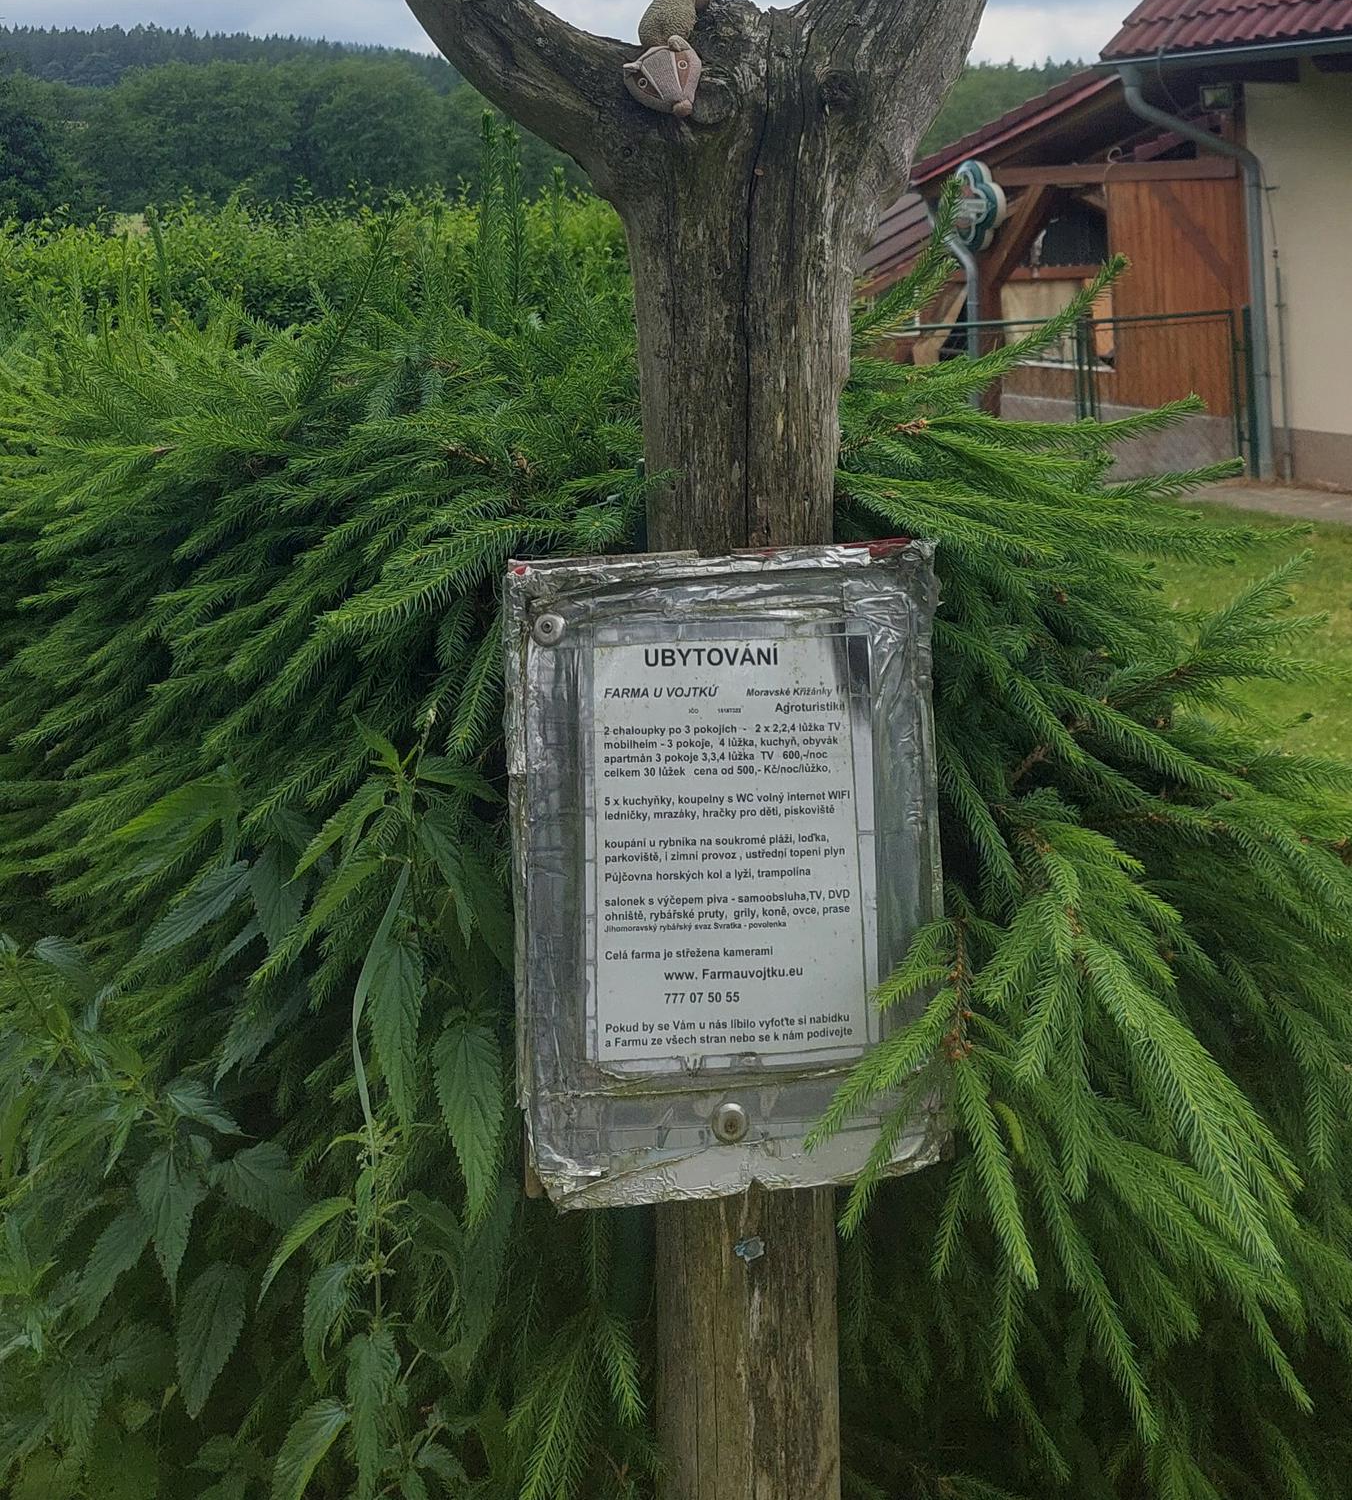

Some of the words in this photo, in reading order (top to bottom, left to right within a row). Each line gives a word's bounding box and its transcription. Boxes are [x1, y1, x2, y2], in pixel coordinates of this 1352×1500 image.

[645, 643, 778, 667] UBYTOVÁNÍ
[604, 688, 649, 698] FARMA
[654, 687, 663, 698] U
[746, 688, 790, 696] Moravské
[793, 687, 832, 697] Křižánky
[604, 726, 609, 735] 2
[613, 726, 666, 737] chaloupky
[669, 727, 681, 736] po
[685, 725, 690, 734] 3
[694, 724, 737, 736] pokojích
[755, 724, 761, 732] 2
[773, 723, 795, 733] 2,2,4
[827, 722, 840, 731] TV
[667, 739, 673, 748] 3
[676, 739, 713, 750] pokoje,
[719, 738, 725, 747] 4
[760, 736, 799, 748] kuchyň,
[803, 736, 838, 747] obyvák
[604, 753, 652, 765] apartmán
[656, 753, 661, 762] 3
[665, 752, 698, 764] pokoje
[702, 752, 725, 763] 3,3,4
[760, 751, 774, 760] TV
[604, 768, 640, 777] celkem
[644, 767, 655, 776] 30
[721, 766, 733, 775] od
[604, 797, 610, 806] 5
[623, 795, 674, 807] kuchyňky,
[678, 794, 724, 806] koupelny
[736, 793, 753, 802] WC
[757, 793, 784, 804] volný
[787, 791, 825, 801] internet
[828, 790, 850, 799] WIFI
[605, 810, 650, 821] ledničky,
[654, 808, 699, 820] mrazáky,
[703, 808, 736, 819] hračky
[740, 809, 756, 819] pro
[760, 806, 781, 817] děti,
[605, 838, 646, 850] koupání
[659, 837, 696, 849] rybníka
[715, 834, 766, 845] soukromé
[605, 852, 661, 865] parkoviště,
[671, 851, 698, 860] zimní
[702, 852, 736, 862] provoz
[790, 847, 821, 859] topení
[824, 846, 845, 858] plyn
[656, 870, 703, 882] horských
[707, 869, 722, 879] kol
[605, 896, 645, 907] salonek
[657, 895, 703, 907] výčepem
[707, 894, 728, 906] piva
[828, 889, 850, 901] DVD
[650, 909, 694, 922] rybářské
[698, 909, 727, 921] pruty,
[734, 908, 759, 920] grily,
[762, 906, 789, 917] koně,
[793, 907, 819, 915] ovce,
[823, 906, 850, 916] prase
[605, 950, 628, 960] Celá
[631, 950, 660, 959] farma
[663, 949, 673, 960] je
[676, 948, 720, 957] střežena
[723, 946, 773, 956] kamerami
[664, 972, 698, 980] www.
[703, 967, 803, 980] Farmauvojtku.eu
[664, 993, 685, 1004] 777
[690, 992, 703, 1003] 07
[708, 992, 721, 1003] 50
[726, 992, 739, 1002] 55
[606, 1022, 638, 1033] Pokud
[642, 1022, 654, 1034] by
[658, 1023, 669, 1031] se
[673, 1020, 695, 1030] Vám
[709, 1020, 727, 1029] nás
[731, 1019, 756, 1028] líbilo
[798, 1015, 806, 1025] si
[810, 1013, 849, 1024] nabídku
[615, 1037, 647, 1047] Farmu
[666, 1034, 696, 1044] všech
[700, 1035, 726, 1044] stran
[730, 1033, 755, 1043] nebo
[774, 1032, 779, 1041] k
[783, 1030, 803, 1040] nám
[807, 1027, 852, 1041] podívejte
